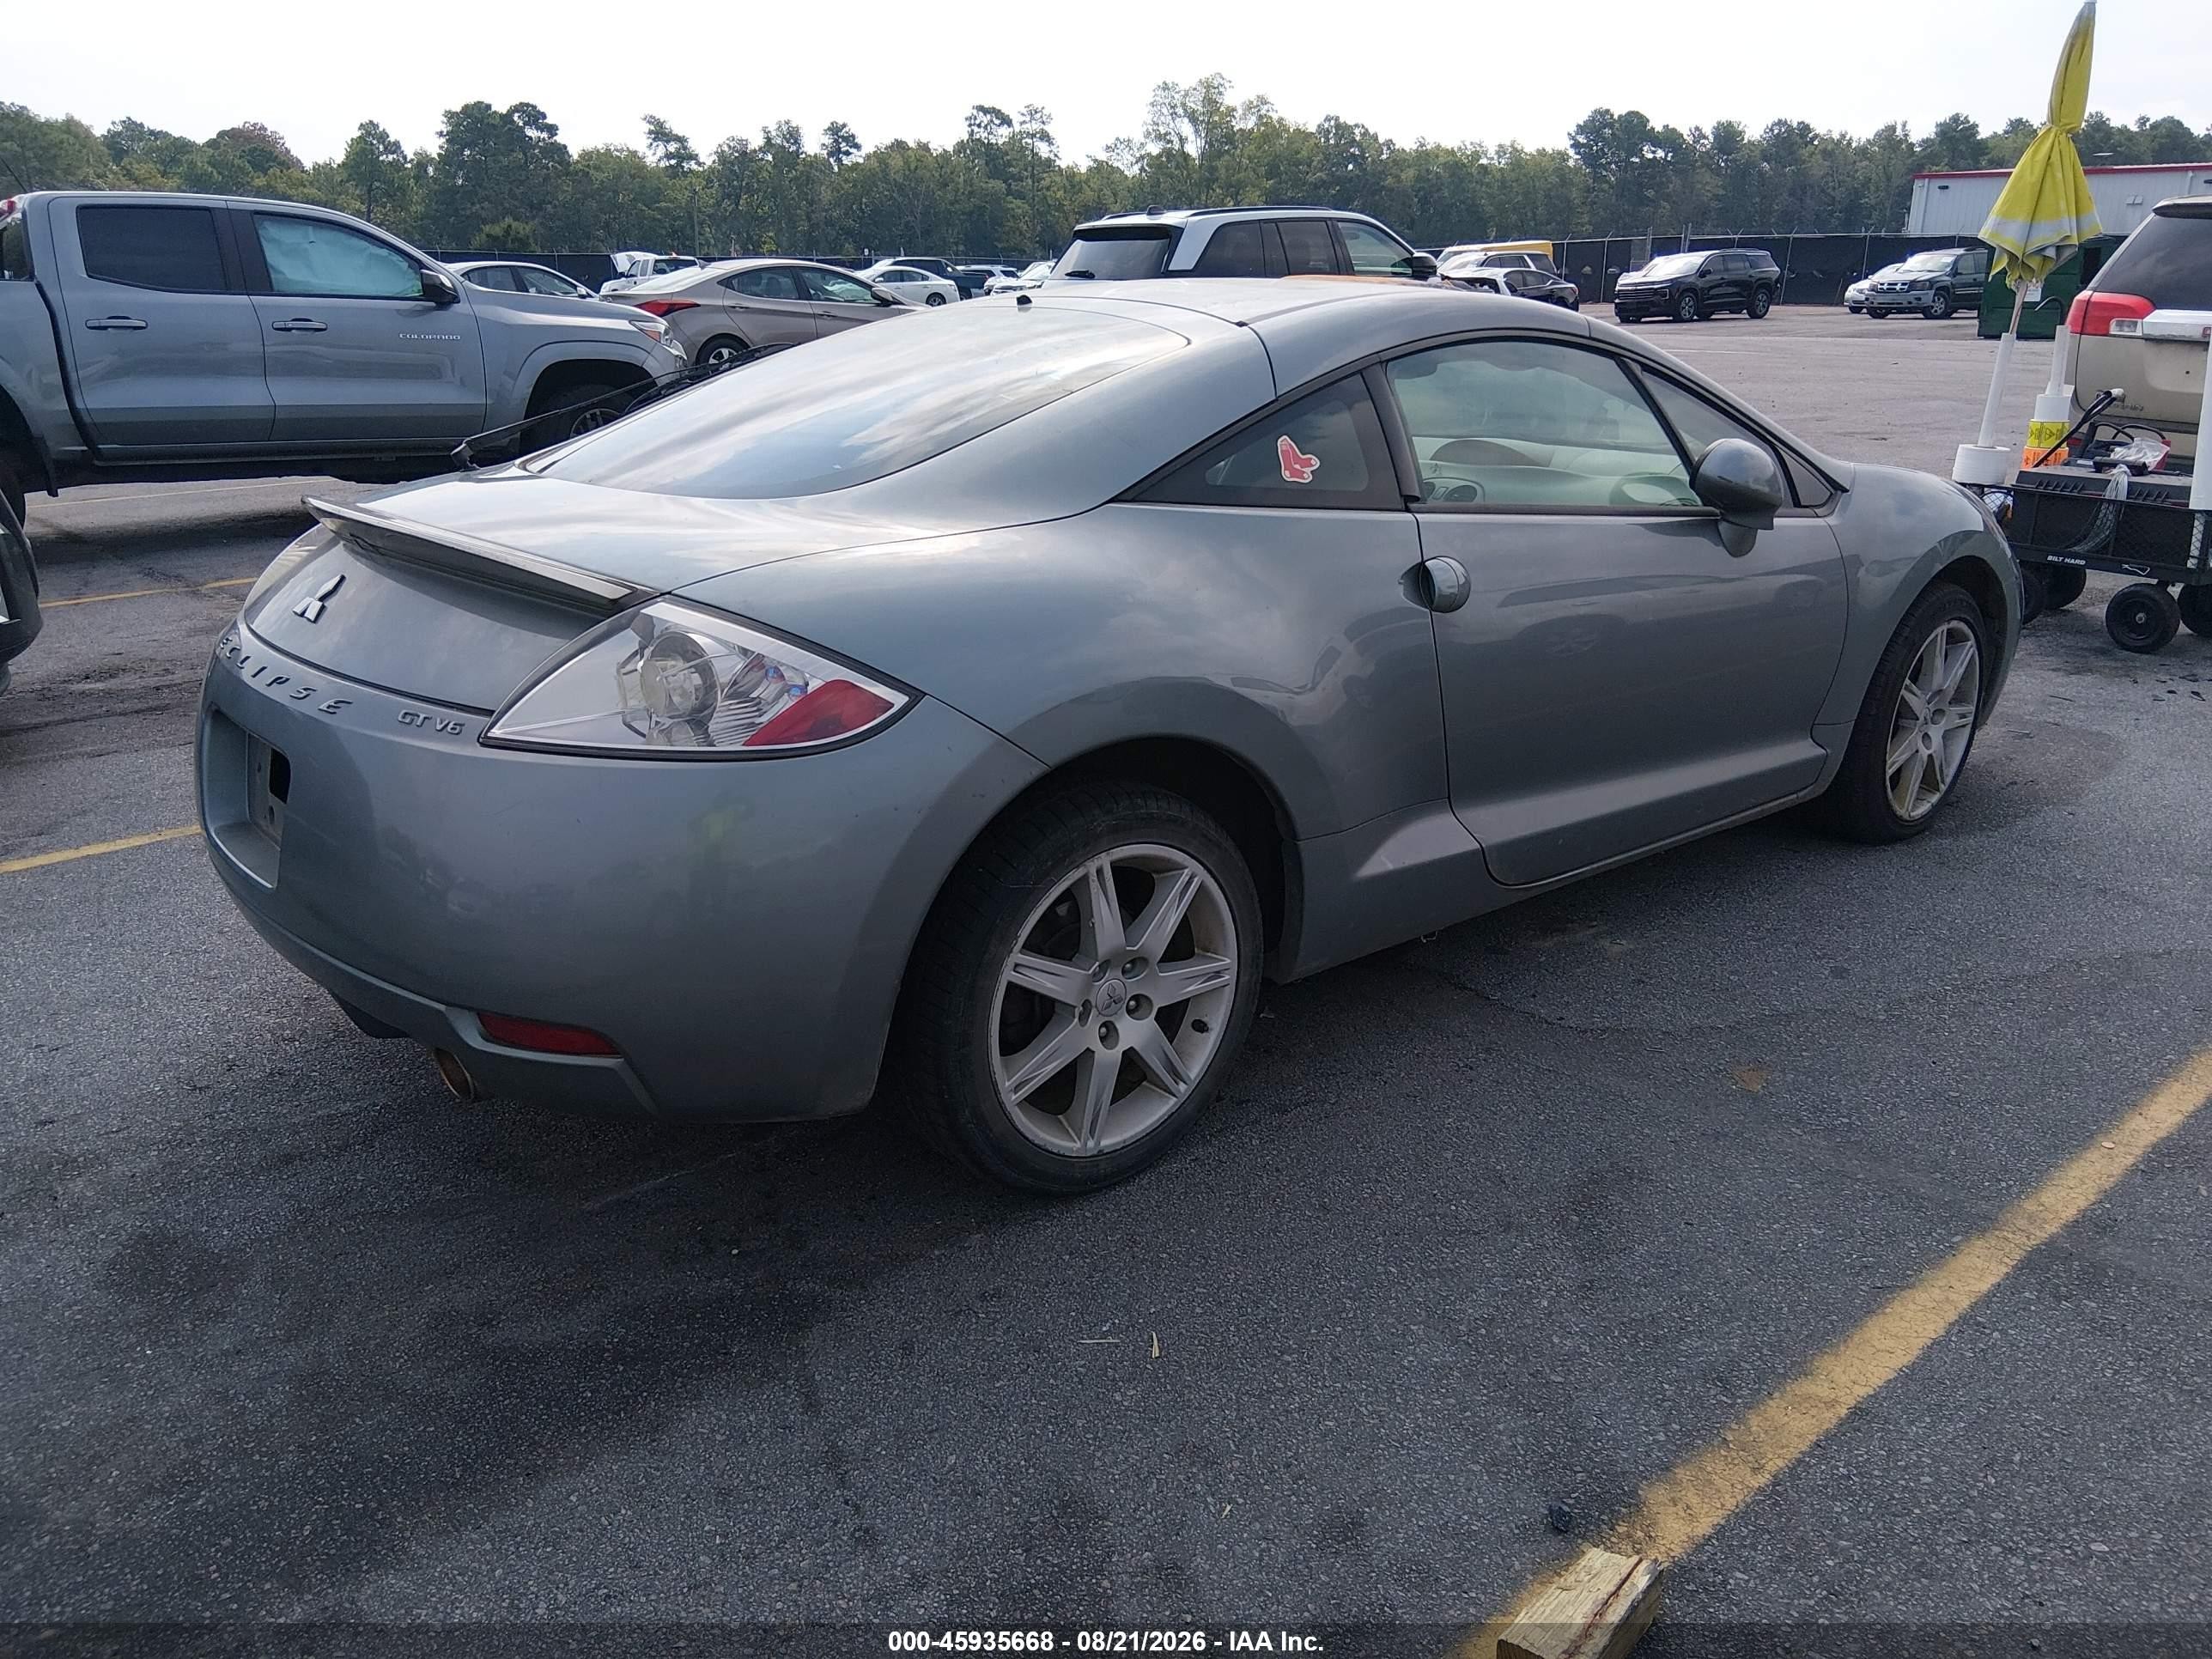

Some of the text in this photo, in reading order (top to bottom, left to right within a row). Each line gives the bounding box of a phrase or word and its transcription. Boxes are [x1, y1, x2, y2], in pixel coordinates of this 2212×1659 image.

[219, 636, 354, 715] ECLIPSE
[397, 709, 465, 736] GT V6
